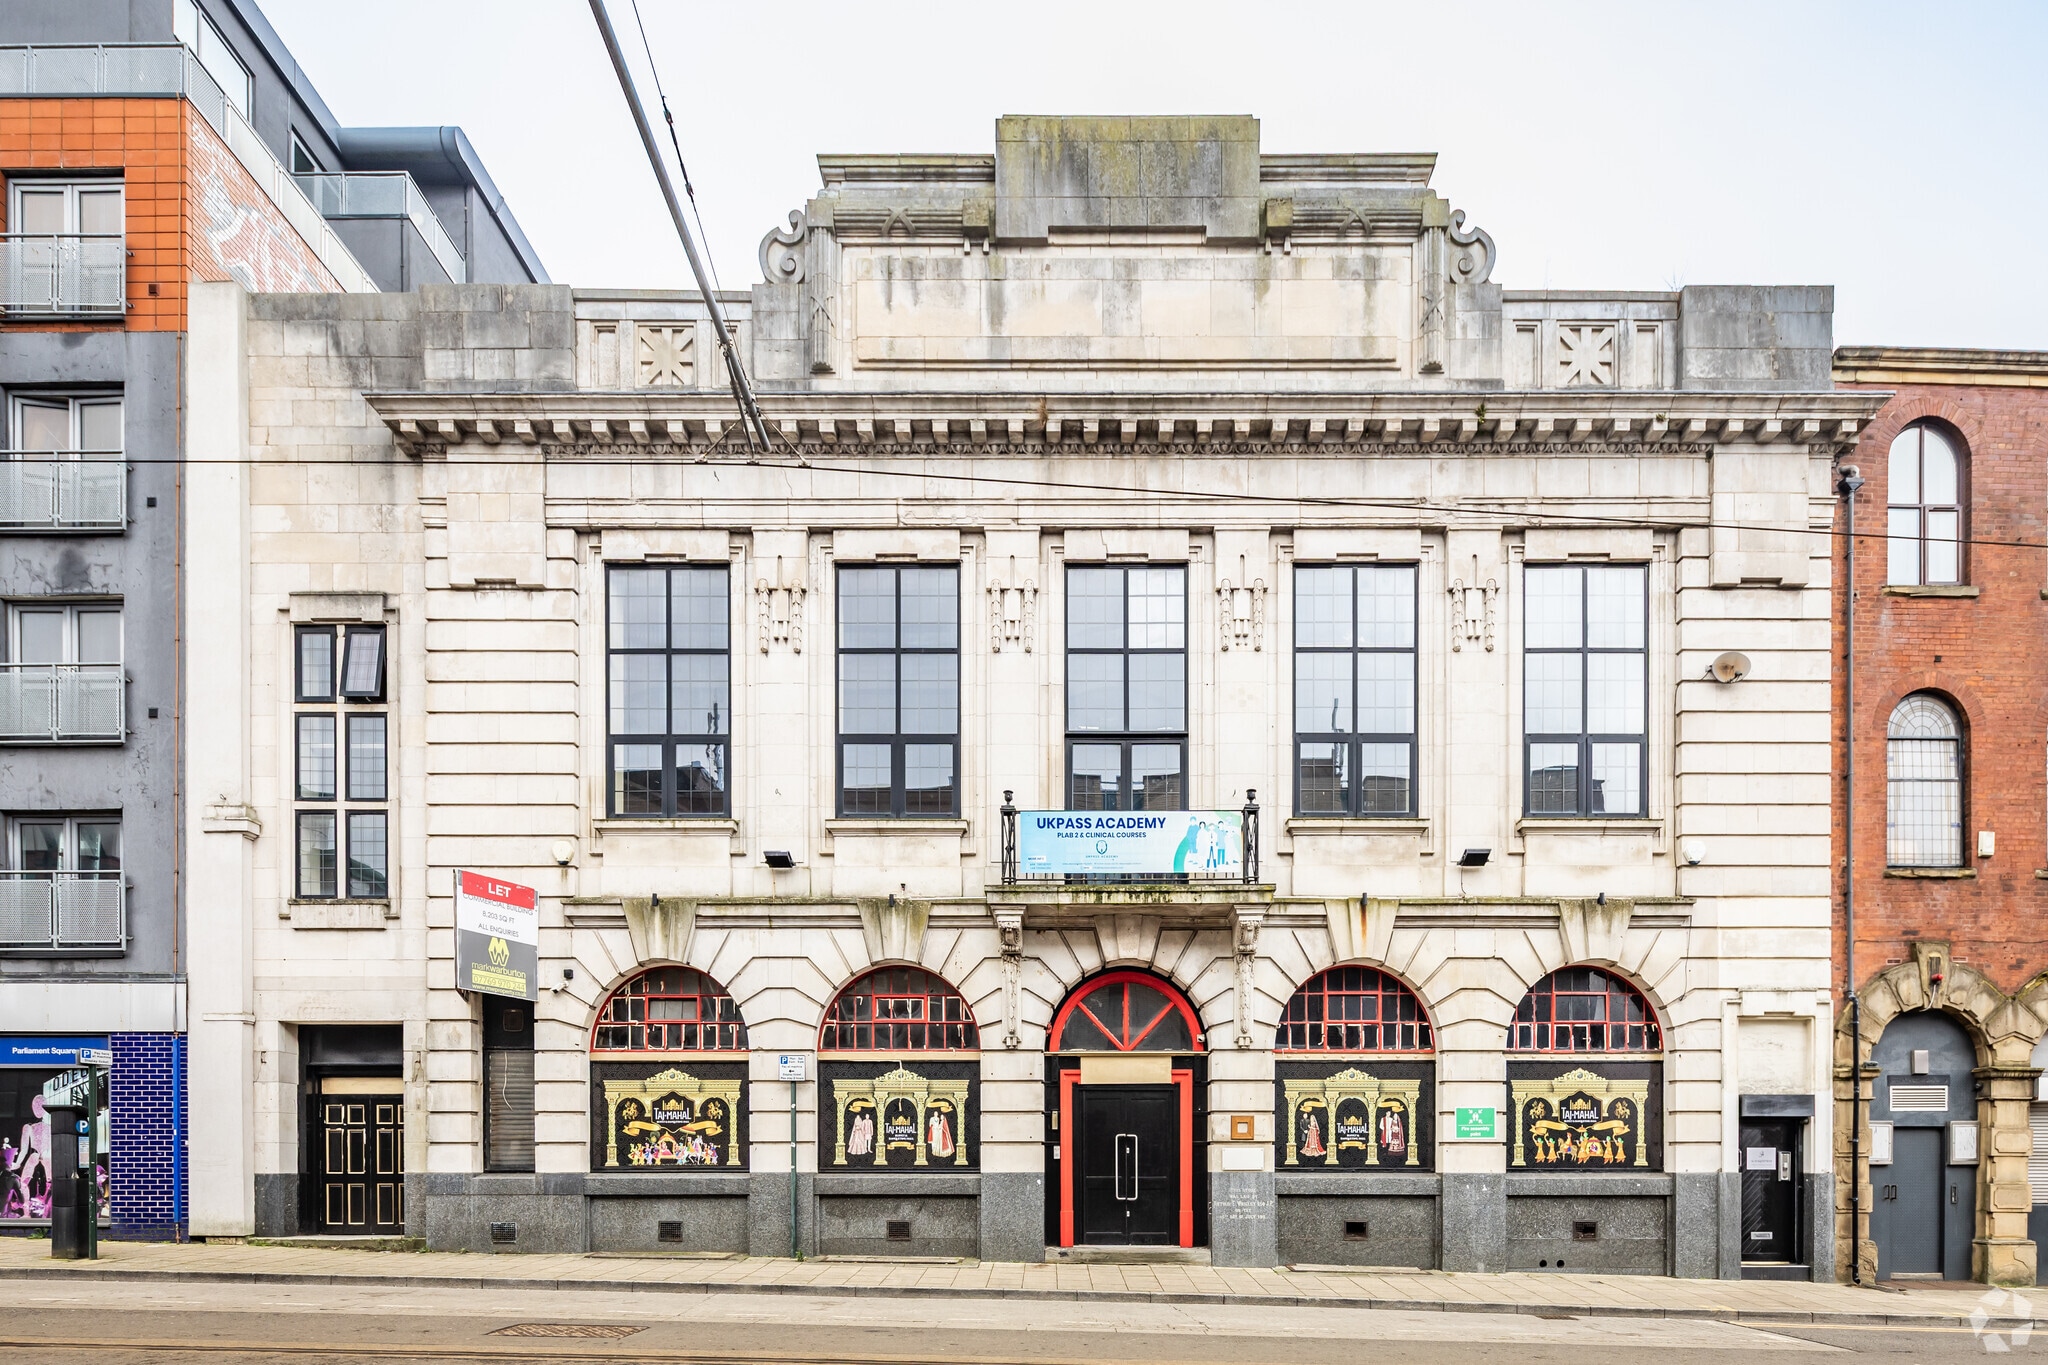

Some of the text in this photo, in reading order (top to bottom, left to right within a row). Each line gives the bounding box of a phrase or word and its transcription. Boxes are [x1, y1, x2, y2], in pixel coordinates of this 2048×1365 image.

[1037, 817, 1166, 829] UKPASS ACADEMY
[488, 882, 511, 897] LET
[506, 904, 534, 916] BUILDING
[490, 926, 519, 937] ENQUIRIES
[472, 962, 526, 978] markwarburton
[474, 975, 524, 991] 07769 970 244
[51, 1048, 76, 1056] Square
[80, 1120, 88, 1132] P
